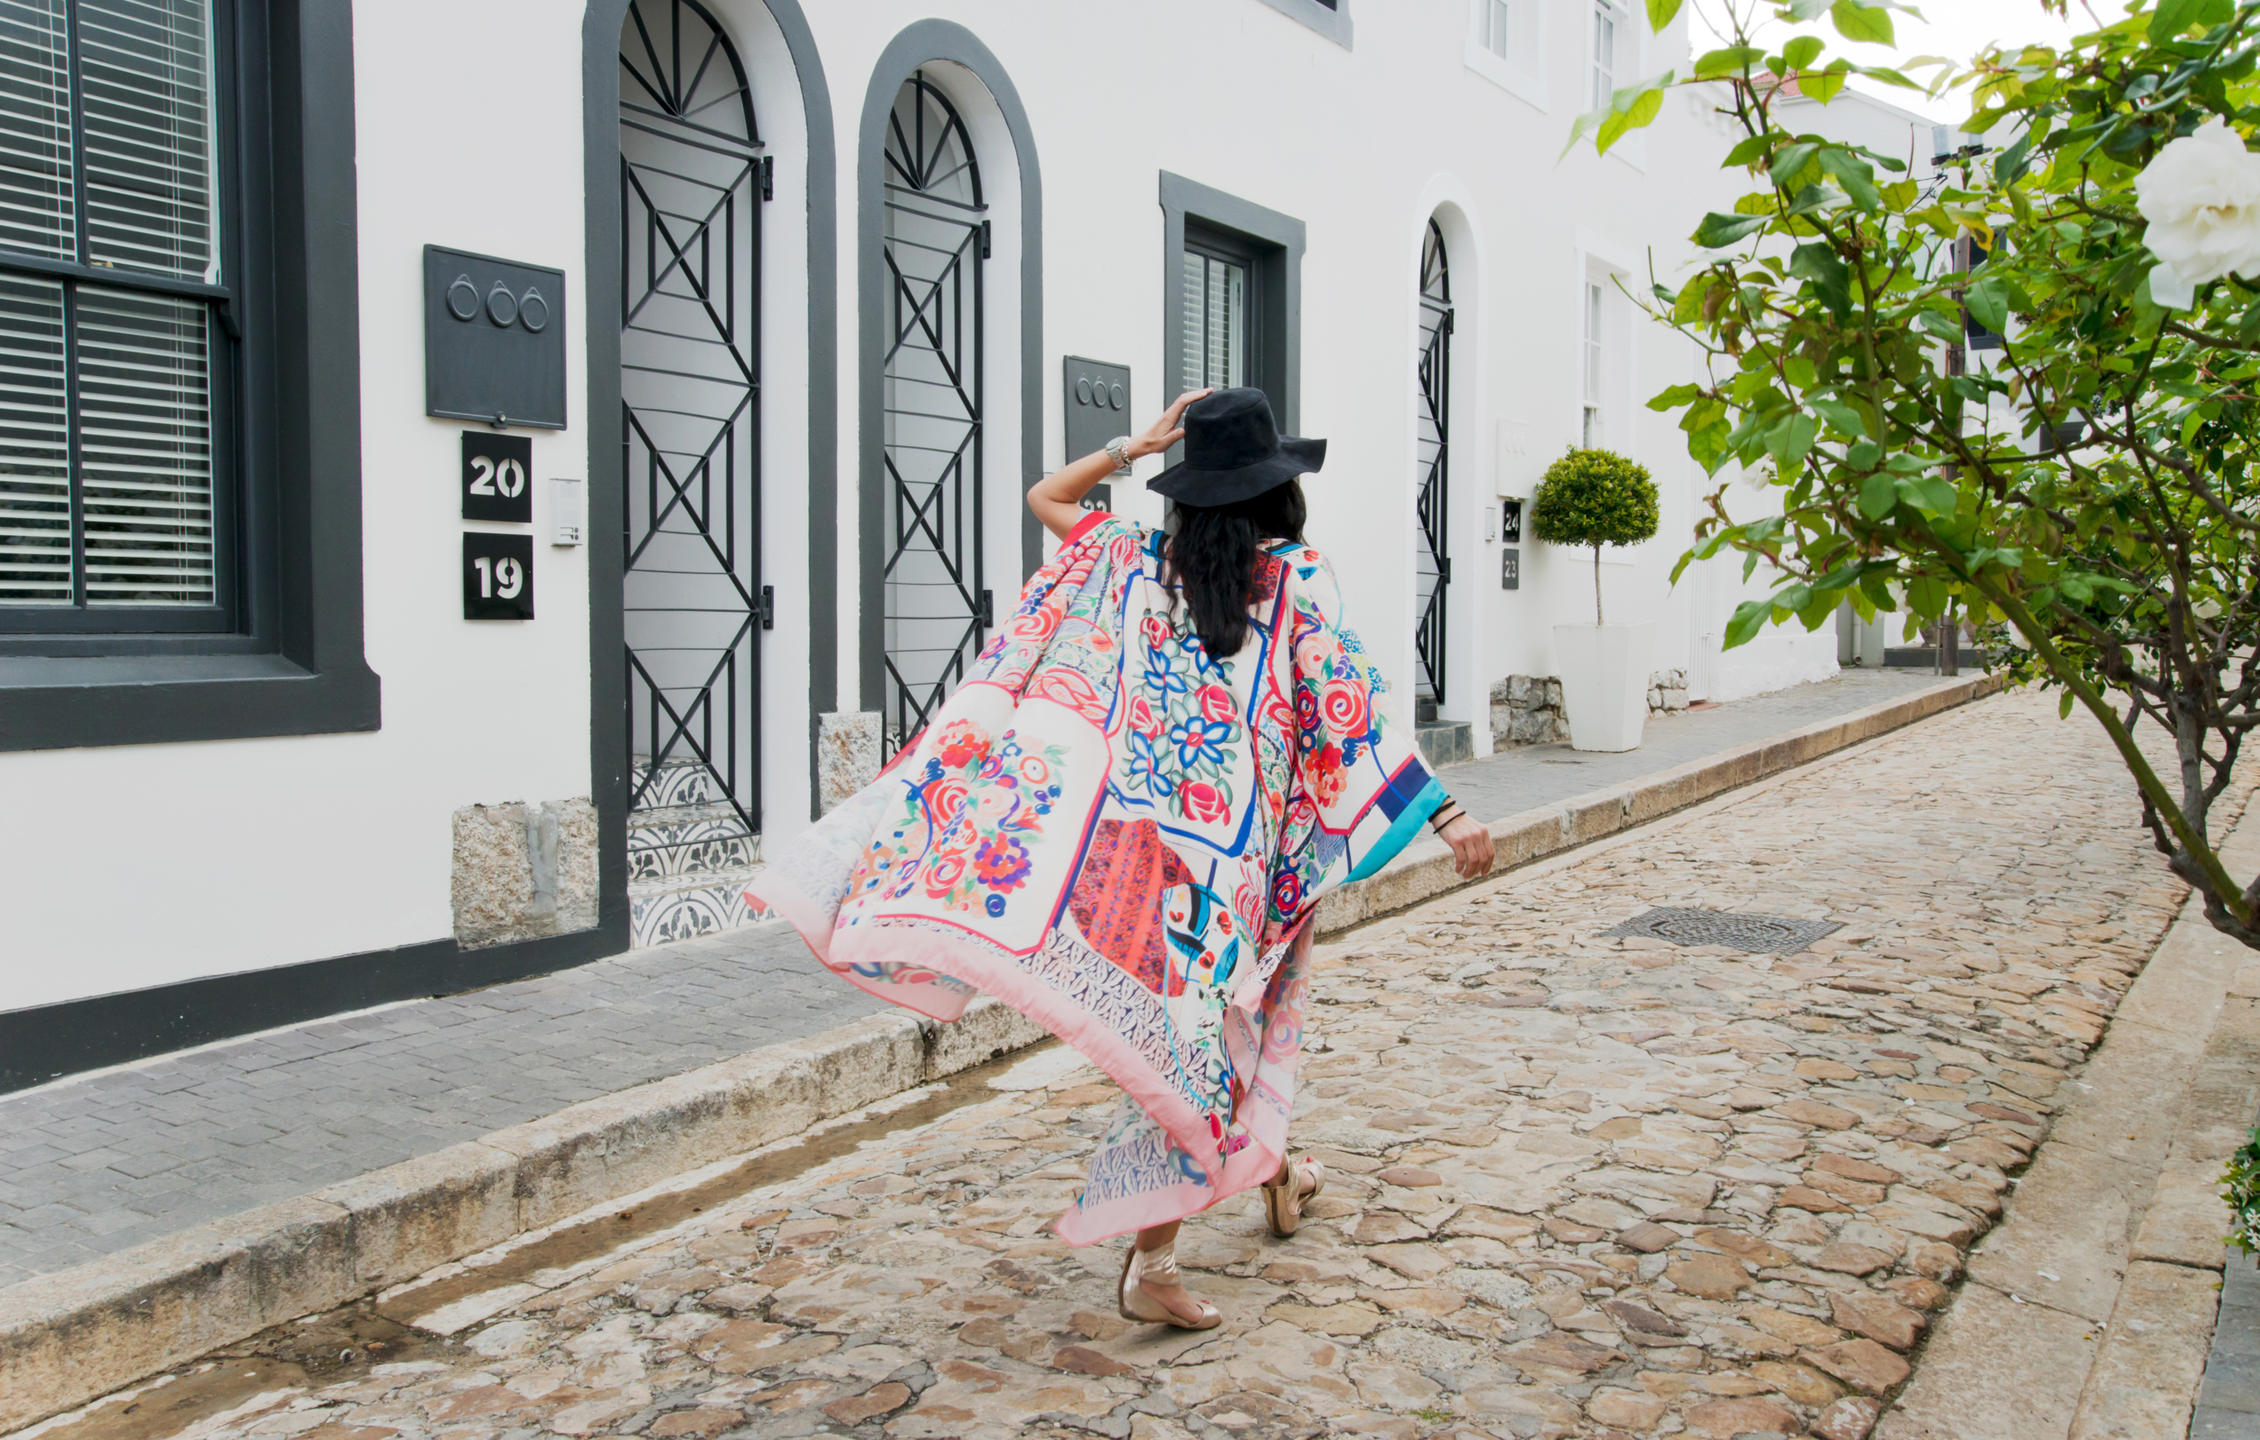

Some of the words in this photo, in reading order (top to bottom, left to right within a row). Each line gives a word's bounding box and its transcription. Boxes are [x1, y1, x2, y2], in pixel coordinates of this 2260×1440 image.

[469, 455, 525, 498] 20
[1505, 512, 1519, 531] 24
[474, 556, 523, 600] 19
[1505, 560, 1516, 578] 23
